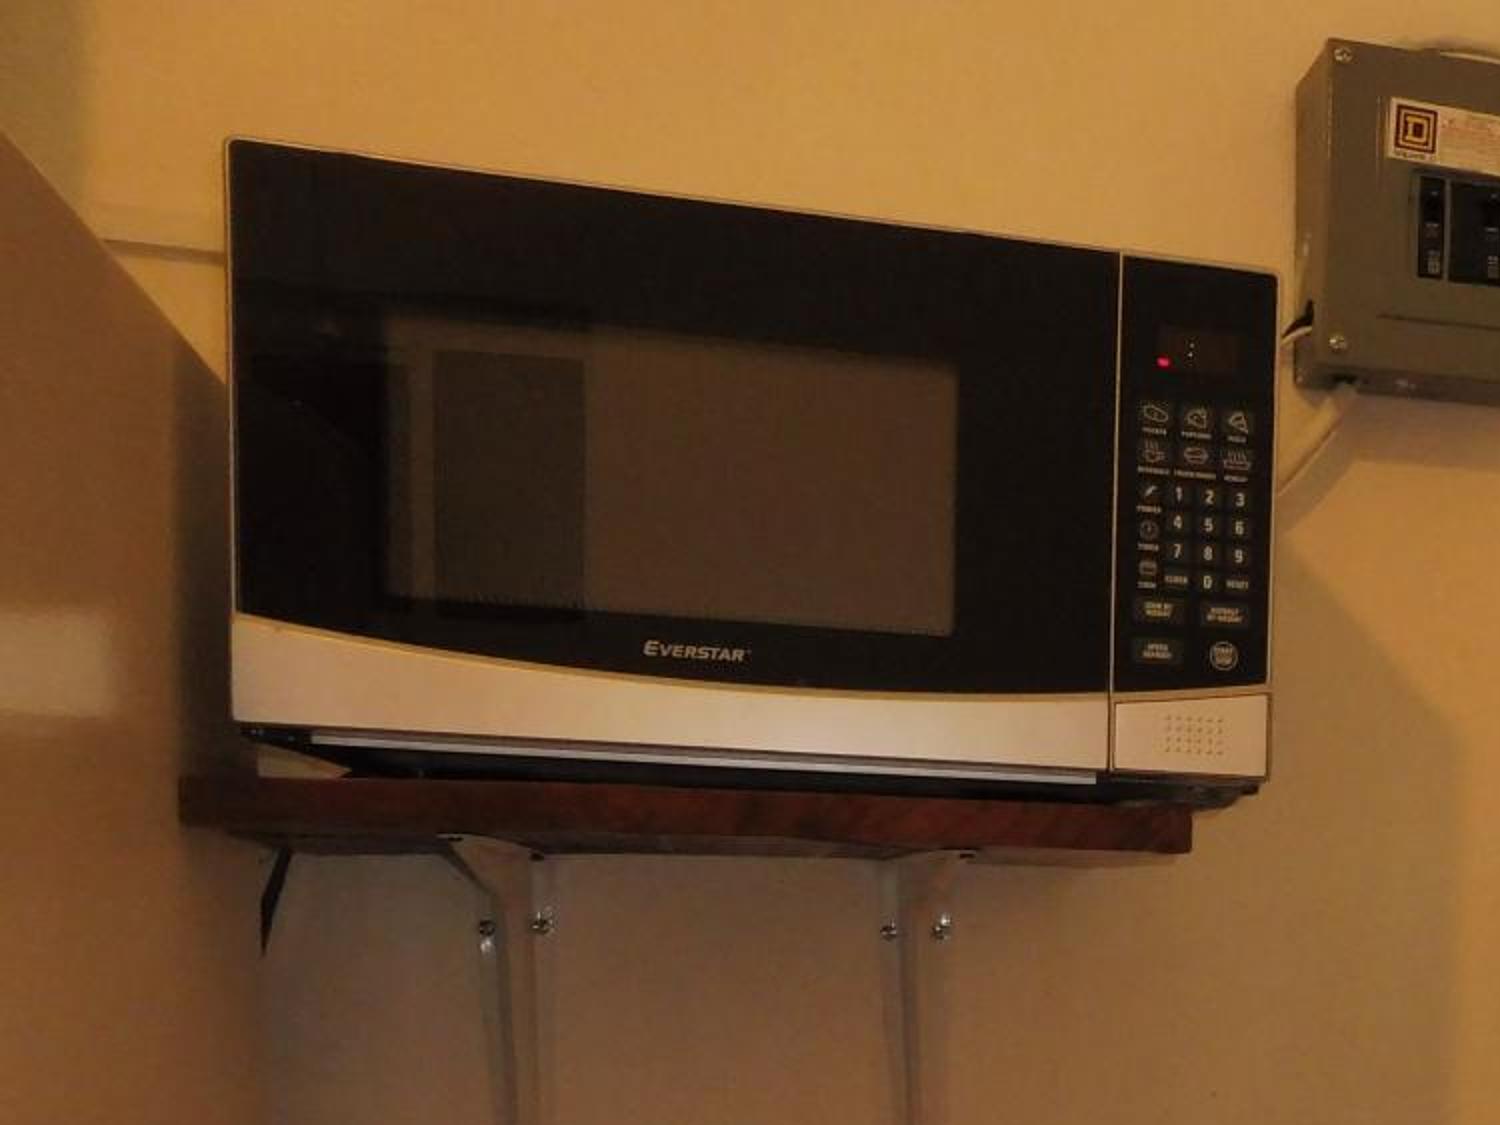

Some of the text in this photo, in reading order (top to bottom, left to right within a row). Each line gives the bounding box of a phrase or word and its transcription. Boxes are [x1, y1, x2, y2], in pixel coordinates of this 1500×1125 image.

[1174, 486, 1245, 508] 1 2 3
[1173, 515, 1244, 536] 4 5 6
[1173, 543, 1182, 559] 7
[1203, 546, 1213, 561] 8
[1234, 549, 1244, 564] 9
[1203, 575, 1213, 589] 0
[642, 639, 746, 661] EVERSTAR
